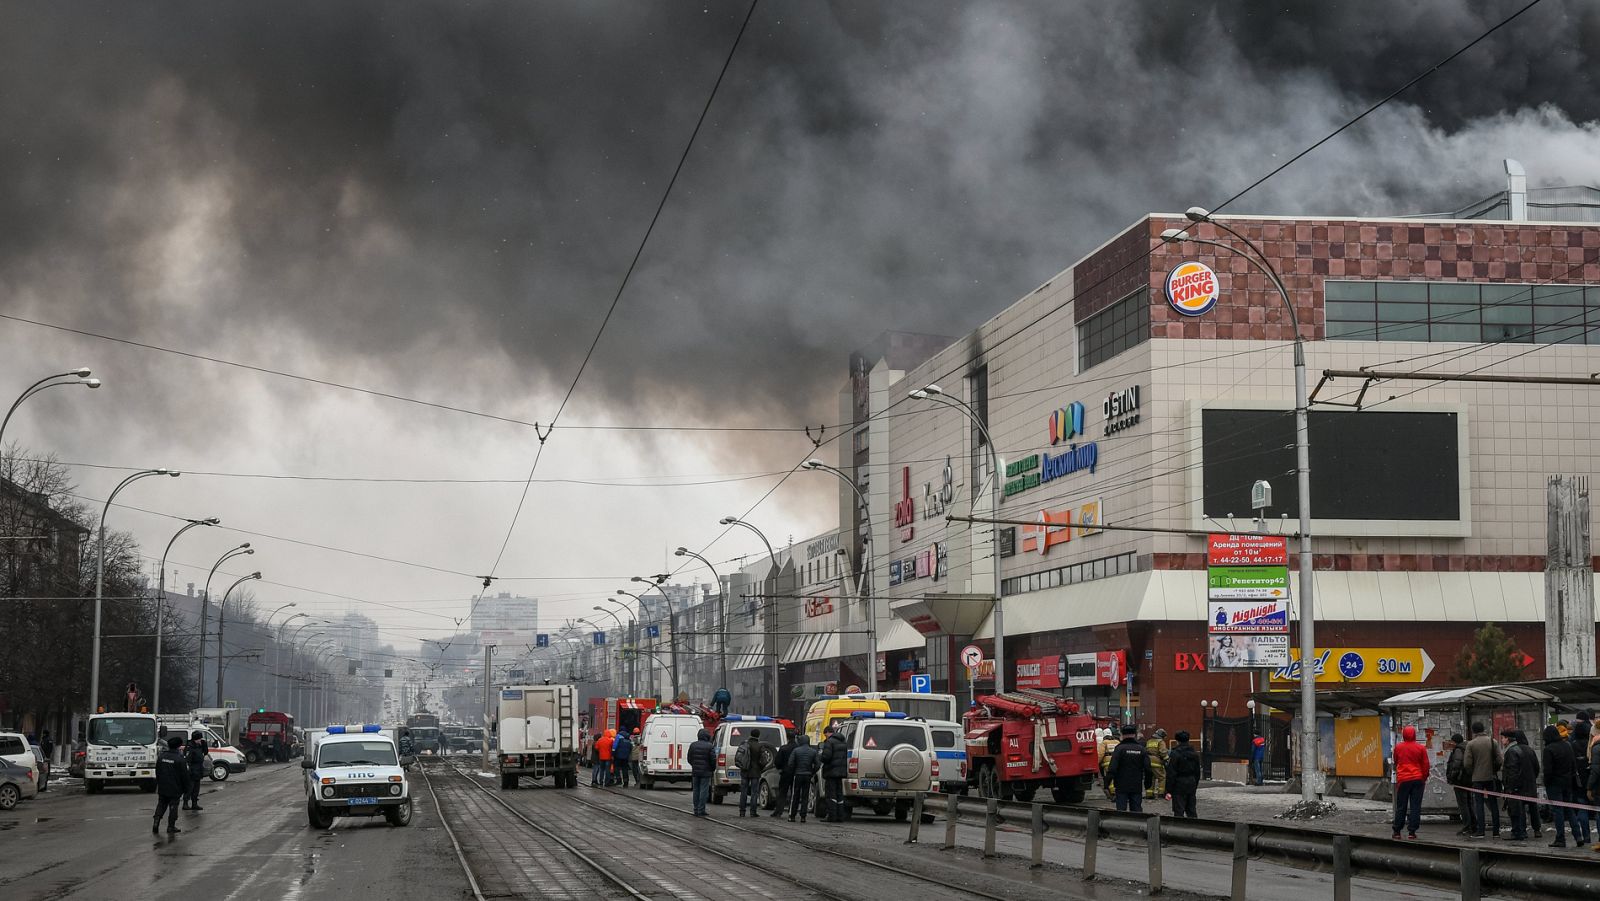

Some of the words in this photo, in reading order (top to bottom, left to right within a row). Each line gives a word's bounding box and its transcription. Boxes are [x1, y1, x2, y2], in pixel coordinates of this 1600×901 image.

[1171, 271, 1212, 290] BURGER
[1173, 280, 1214, 304] KING
[1213, 541, 1239, 549] Аренда
[1220, 556, 1252, 564] 44-22-50,
[1232, 577, 1284, 585] Репетитор42
[1232, 603, 1276, 623] Highlight
[1175, 653, 1207, 671] ВХ
[915, 677, 927, 692] P
